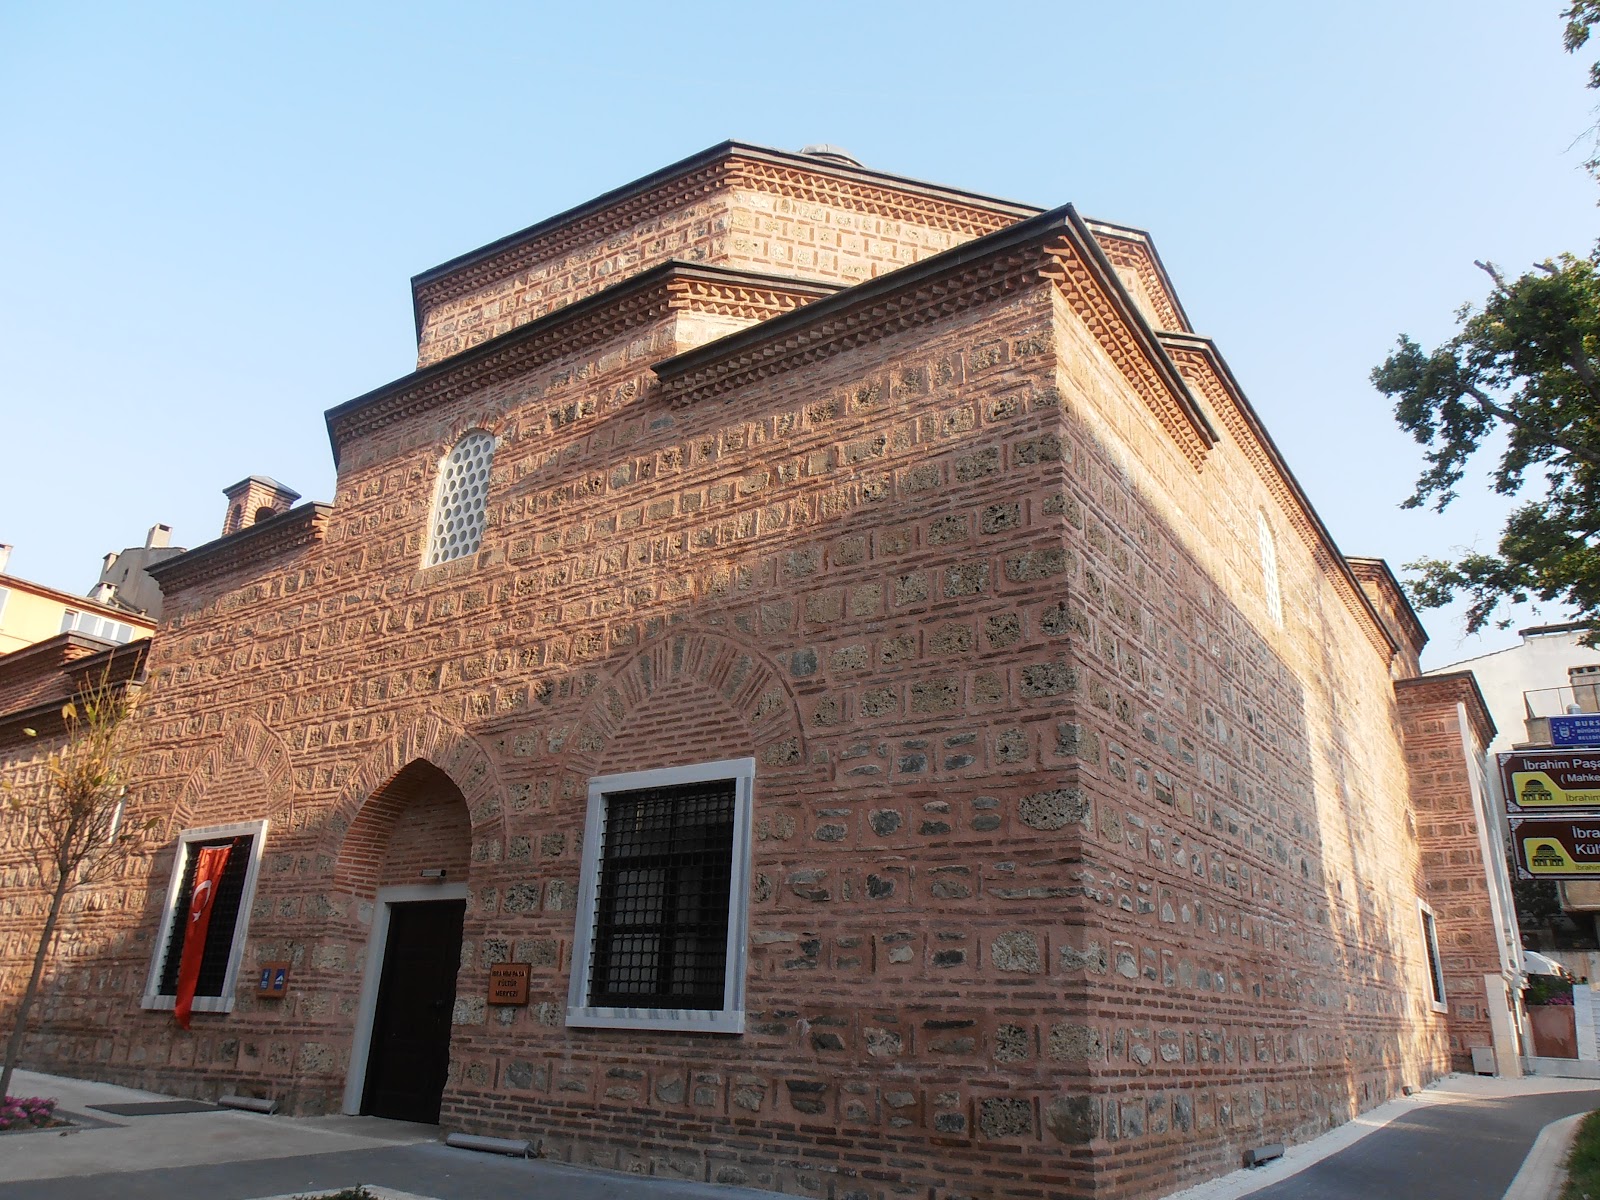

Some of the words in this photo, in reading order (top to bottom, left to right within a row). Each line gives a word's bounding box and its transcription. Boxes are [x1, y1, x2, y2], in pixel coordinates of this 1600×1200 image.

[1523, 758, 1570, 770] İbrahim
[1572, 825, 1600, 839] İbra
[1575, 843, 1600, 855] Kül
